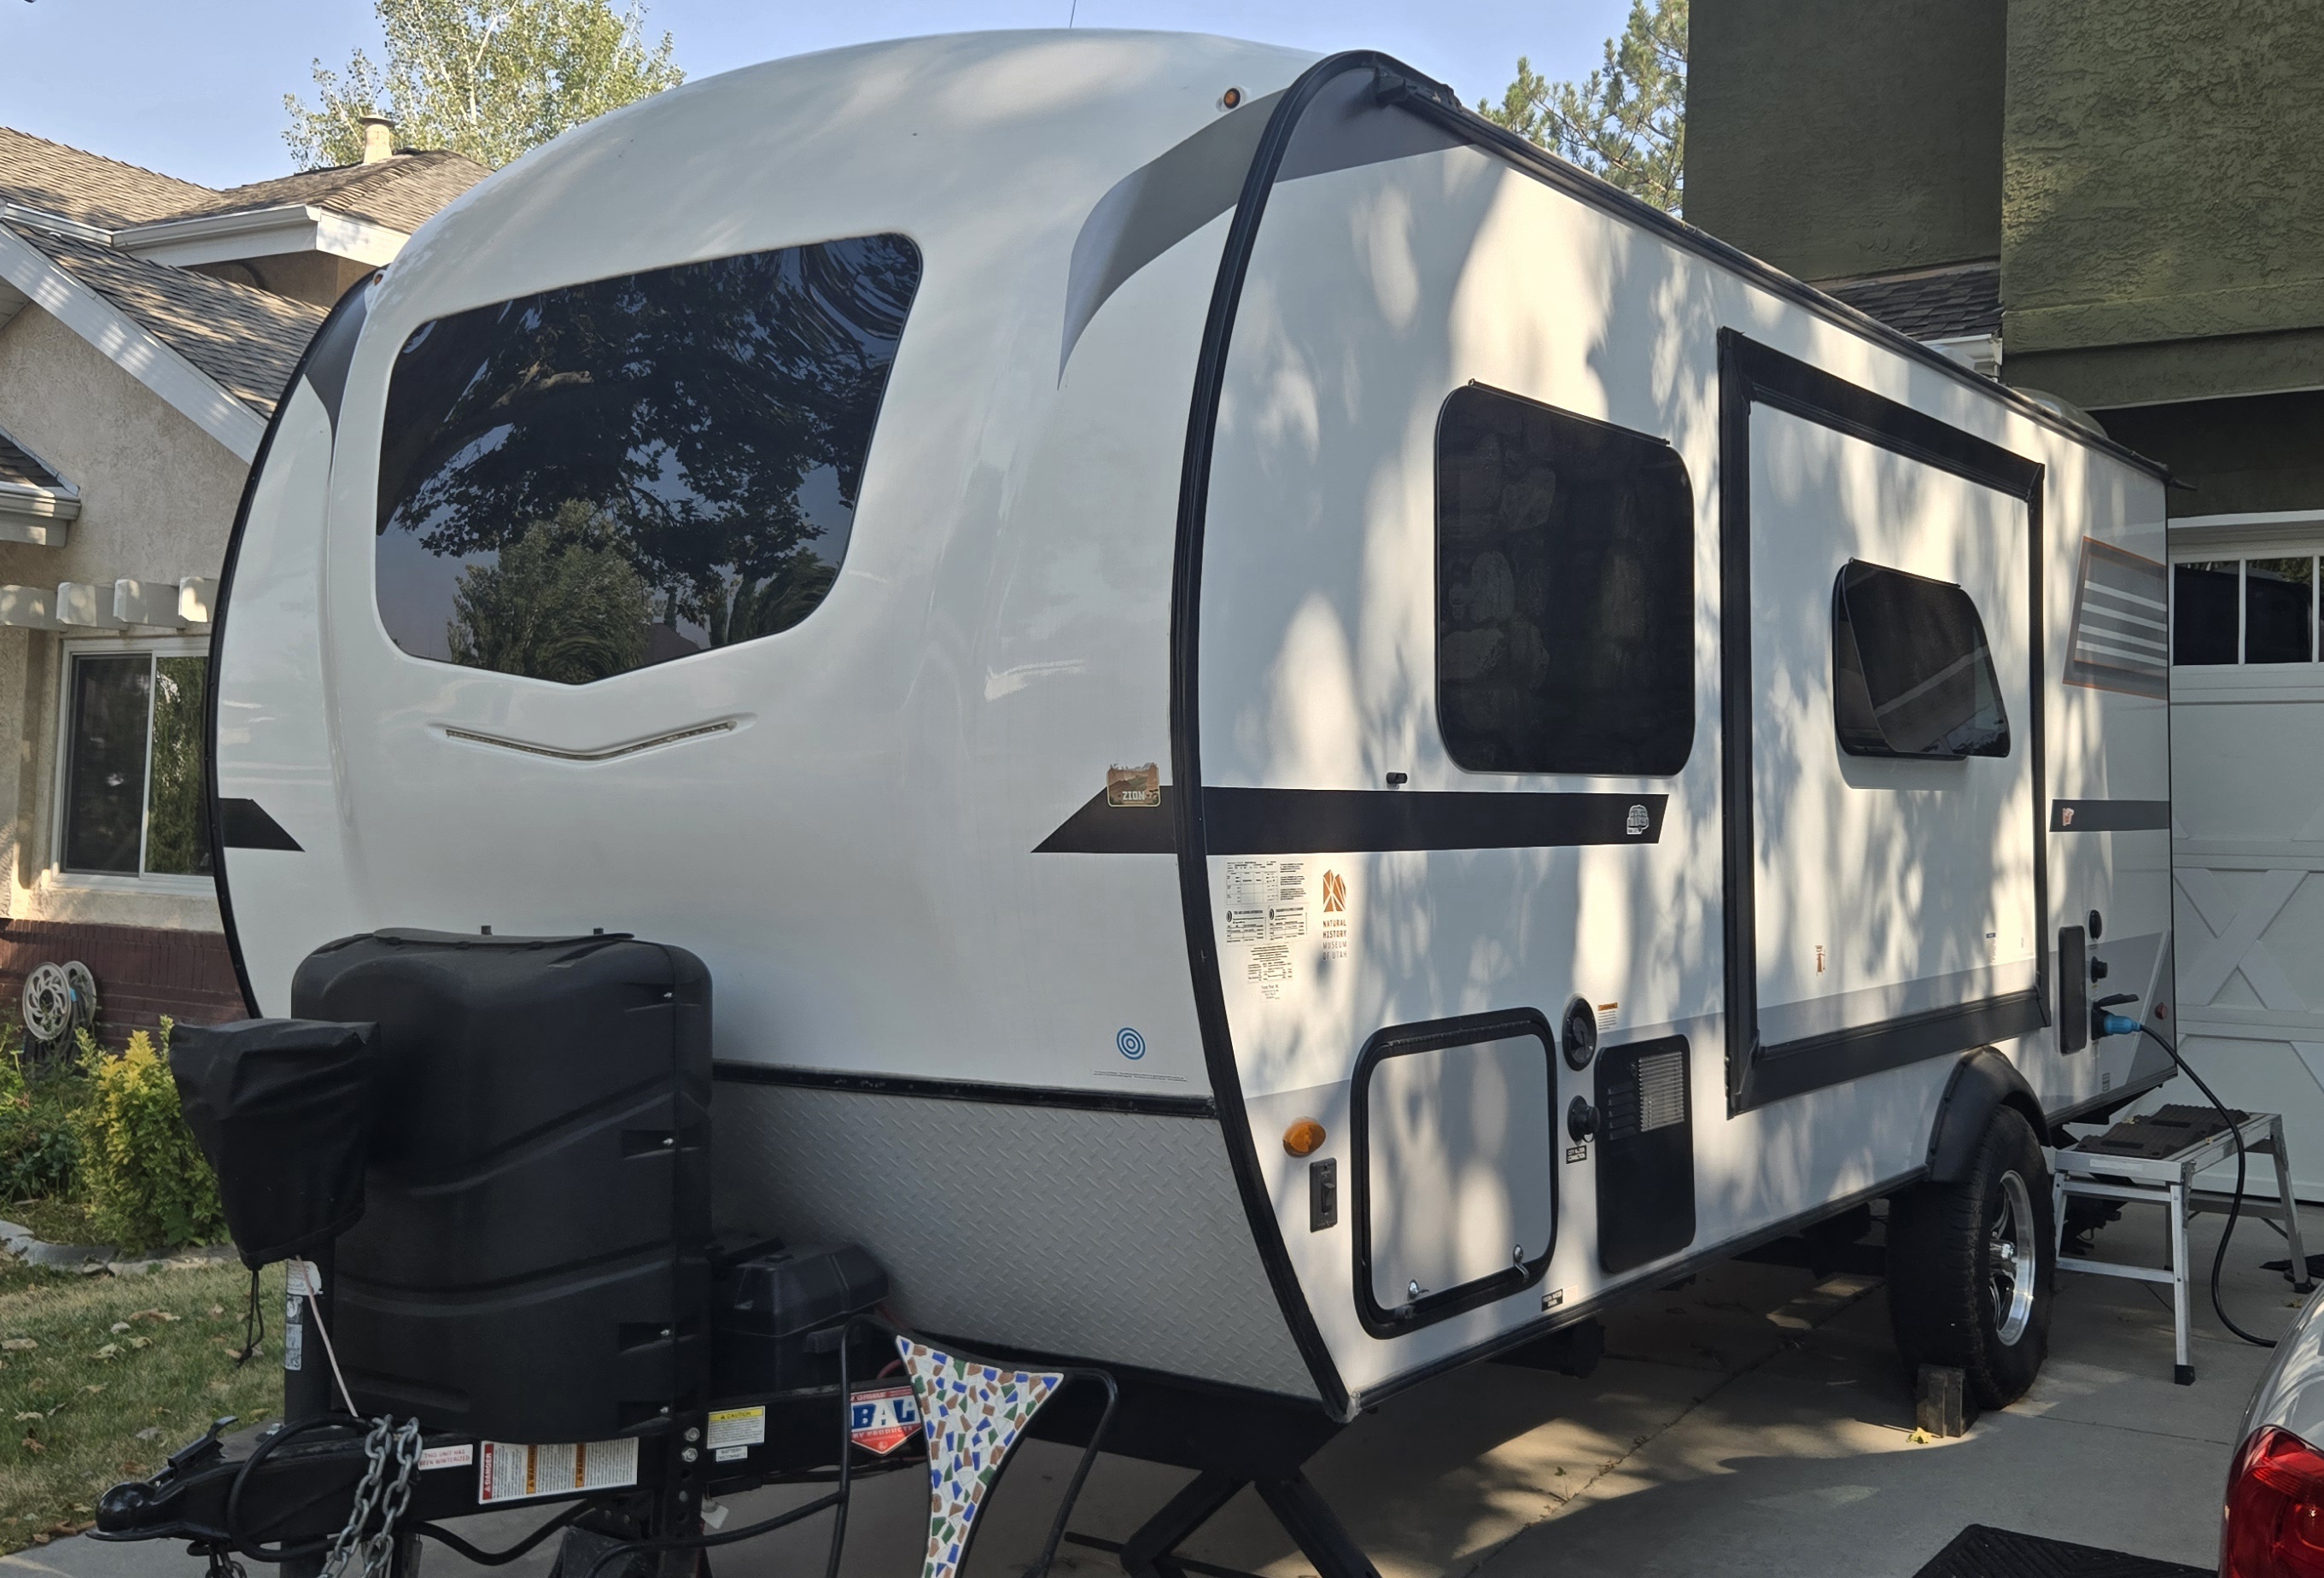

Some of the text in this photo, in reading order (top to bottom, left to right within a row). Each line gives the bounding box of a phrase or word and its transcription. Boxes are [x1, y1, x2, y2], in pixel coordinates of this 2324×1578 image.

[1122, 791, 1146, 800] ZION
[1323, 919, 1346, 927] NATURAL
[1323, 930, 1346, 938] HISTORY
[1323, 940, 1346, 949] MUSEUM
[1323, 950, 1347, 960] OF UTAH
[851, 1399, 915, 1430] BAL
[867, 1425, 913, 1436] PRODUCTS
